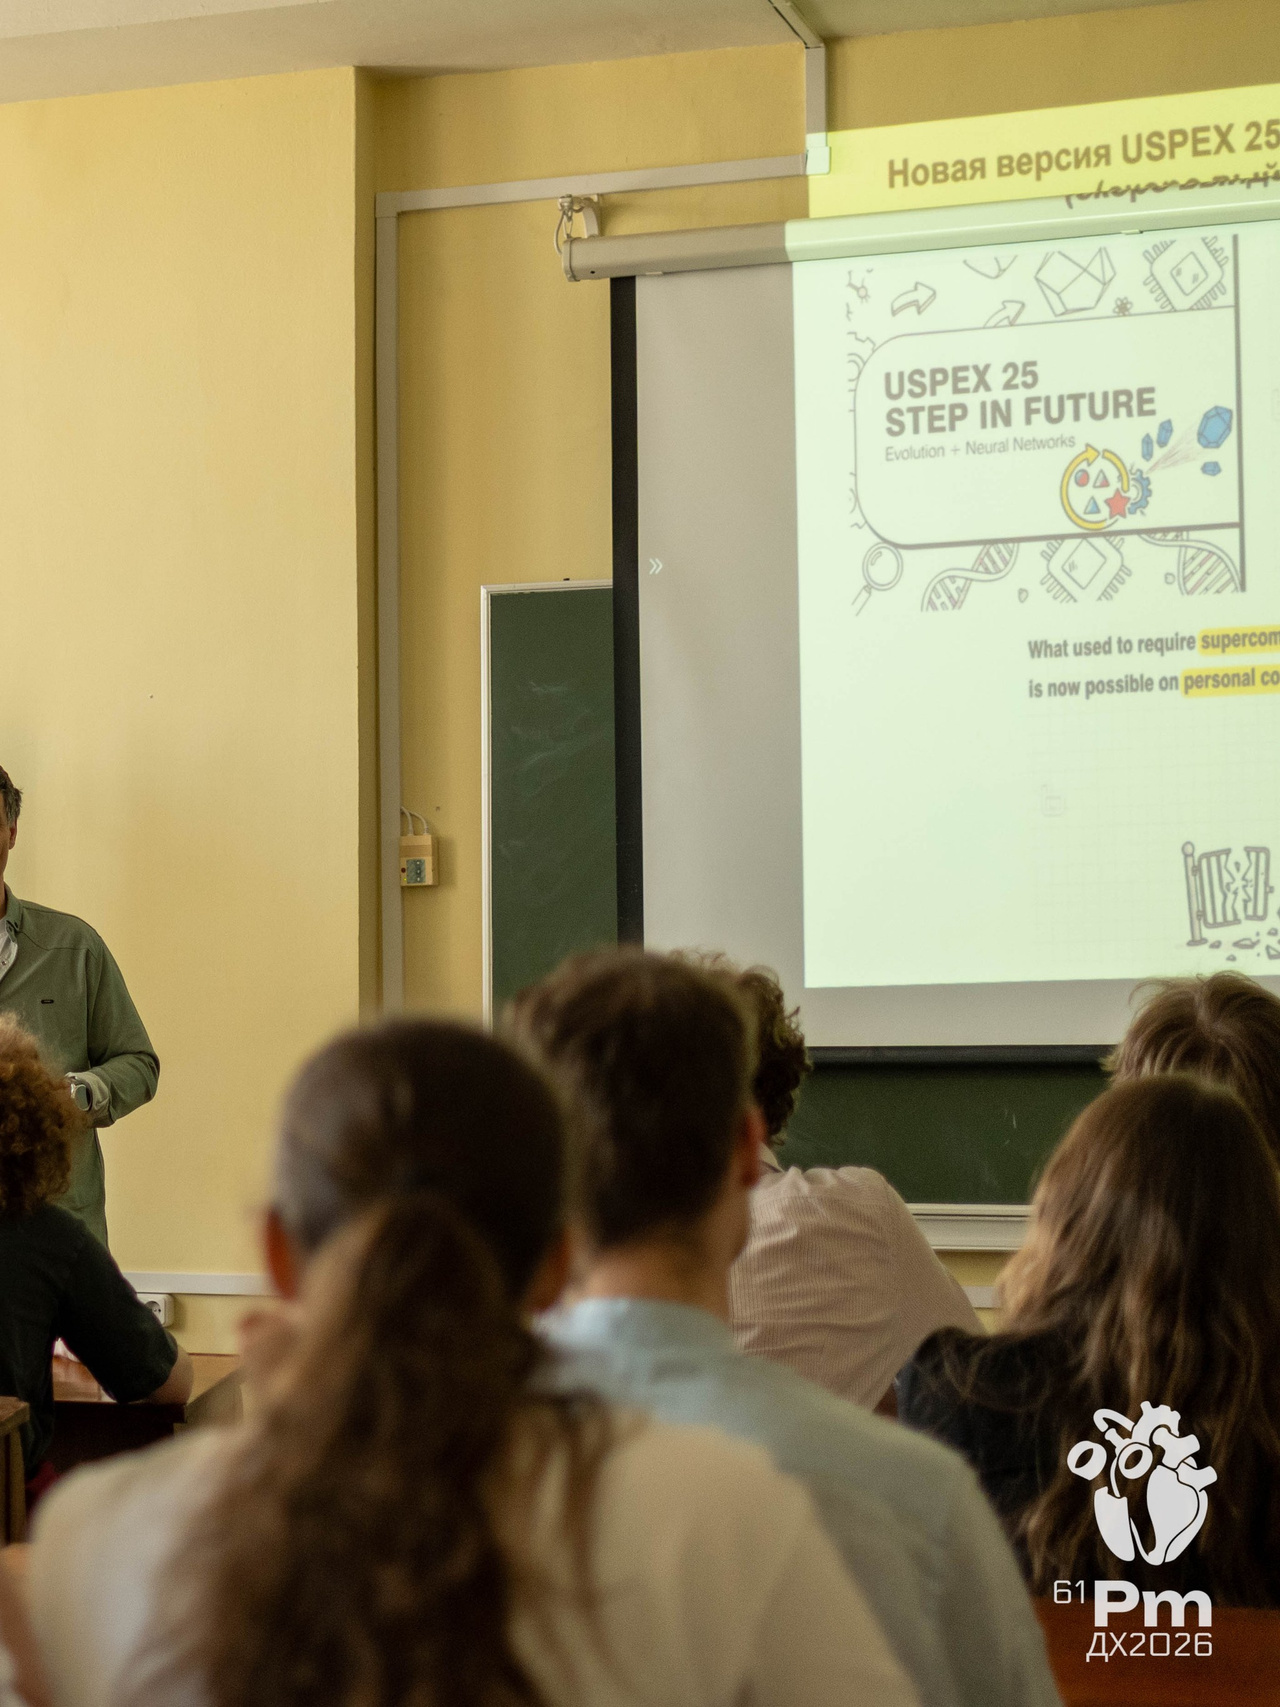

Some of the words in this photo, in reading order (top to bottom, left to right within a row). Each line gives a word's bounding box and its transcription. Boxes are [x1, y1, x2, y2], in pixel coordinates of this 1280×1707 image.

[887, 157, 986, 189] Новая
[996, 143, 1112, 181] версия
[1121, 122, 1236, 164] USPEX
[884, 363, 992, 401] USPEX
[1001, 360, 1039, 391] 25
[885, 402, 969, 437] STEP
[980, 398, 1012, 429] IN
[1024, 386, 1157, 426] FUTURE
[885, 445, 946, 462] Evolution
[965, 438, 1009, 456] Neural
[1013, 434, 1076, 451] Networks
[1028, 639, 1069, 659] What
[1072, 636, 1113, 656] used
[1116, 636, 1133, 654] to
[1137, 632, 1196, 657] require
[1028, 679, 1043, 698] is
[1047, 681, 1081, 696] now
[1085, 673, 1154, 700] possible
[1158, 675, 1179, 691] on
[1184, 667, 1256, 695] personal
